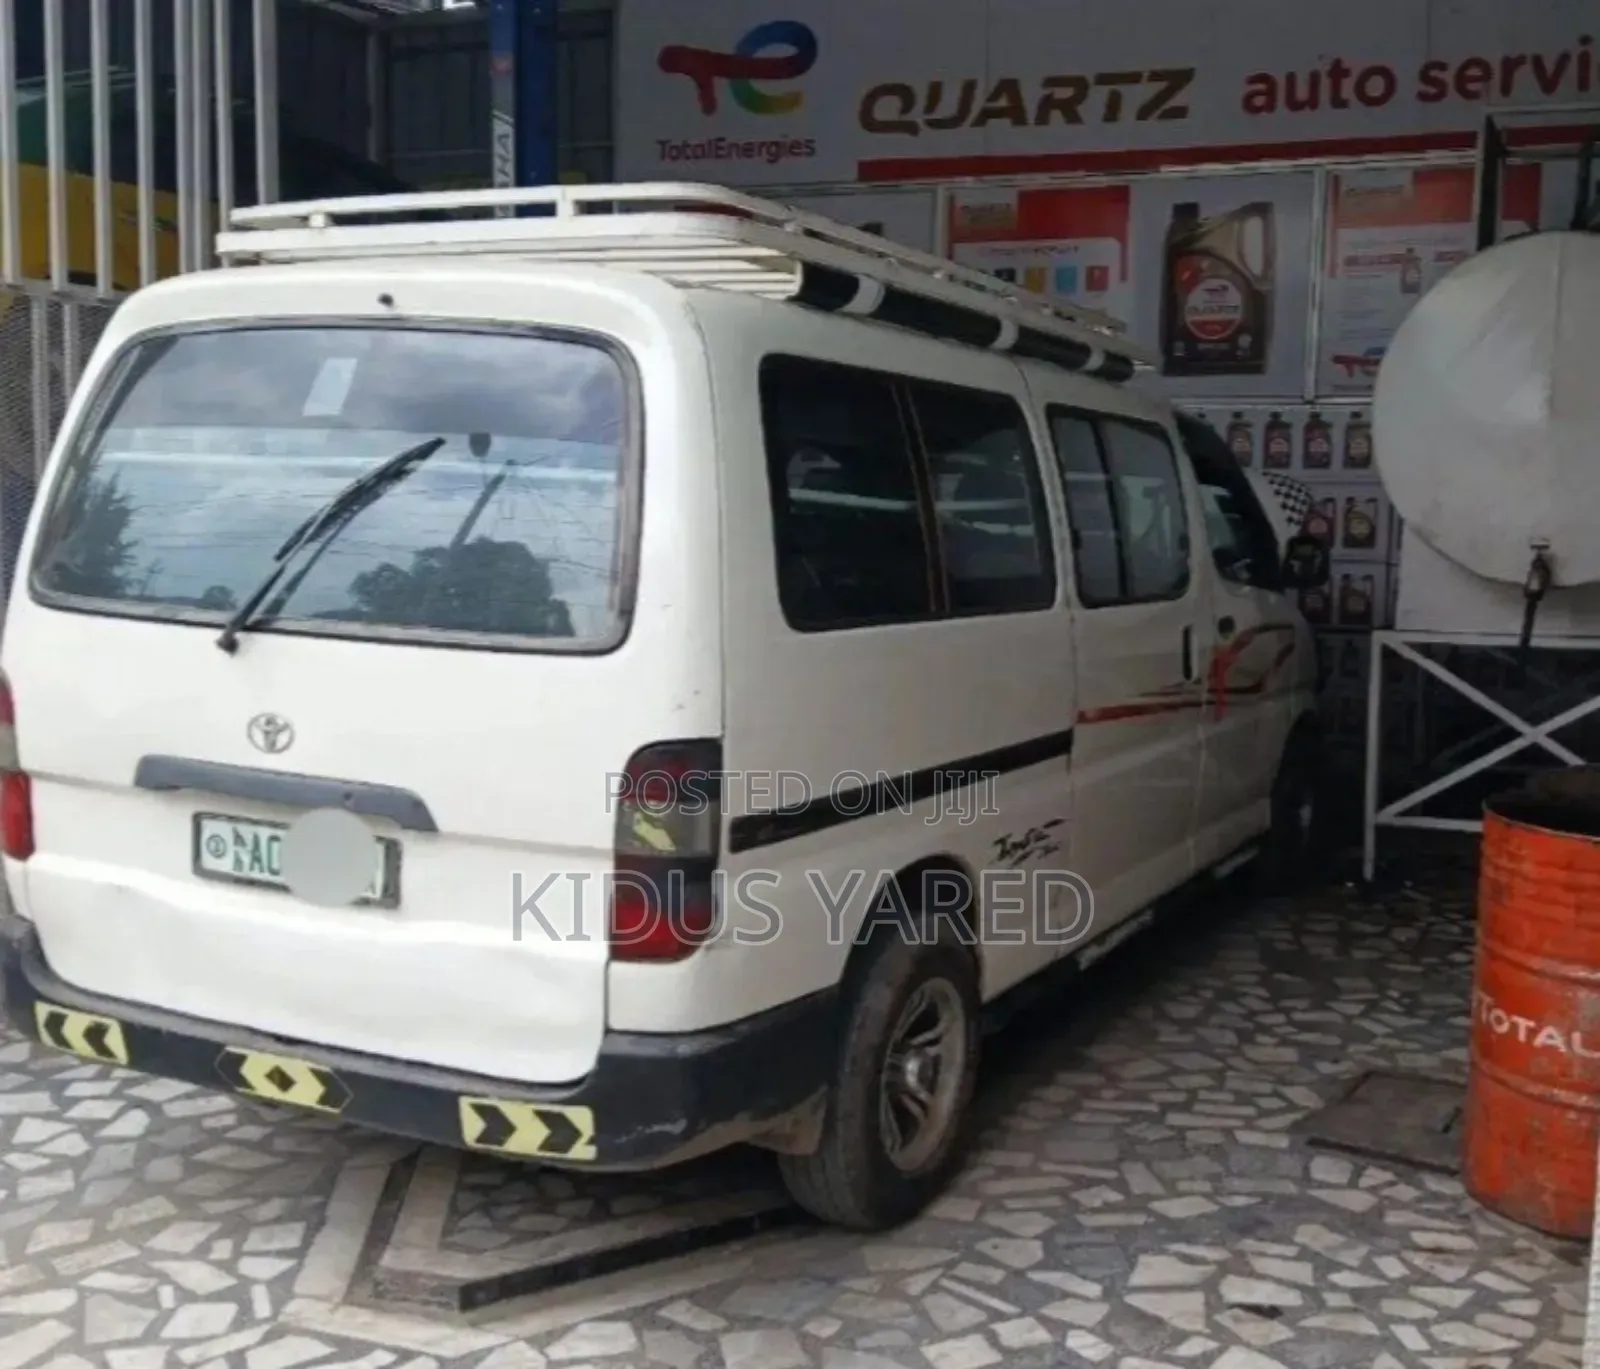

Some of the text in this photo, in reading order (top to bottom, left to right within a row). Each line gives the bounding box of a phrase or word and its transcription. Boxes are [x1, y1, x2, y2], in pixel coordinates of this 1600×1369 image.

[858, 67, 1196, 137] QUARTZ
[1242, 33, 1600, 115] auto servi
[656, 133, 817, 164] TotalEnergies
[1478, 990, 1600, 1059] TOTAL
